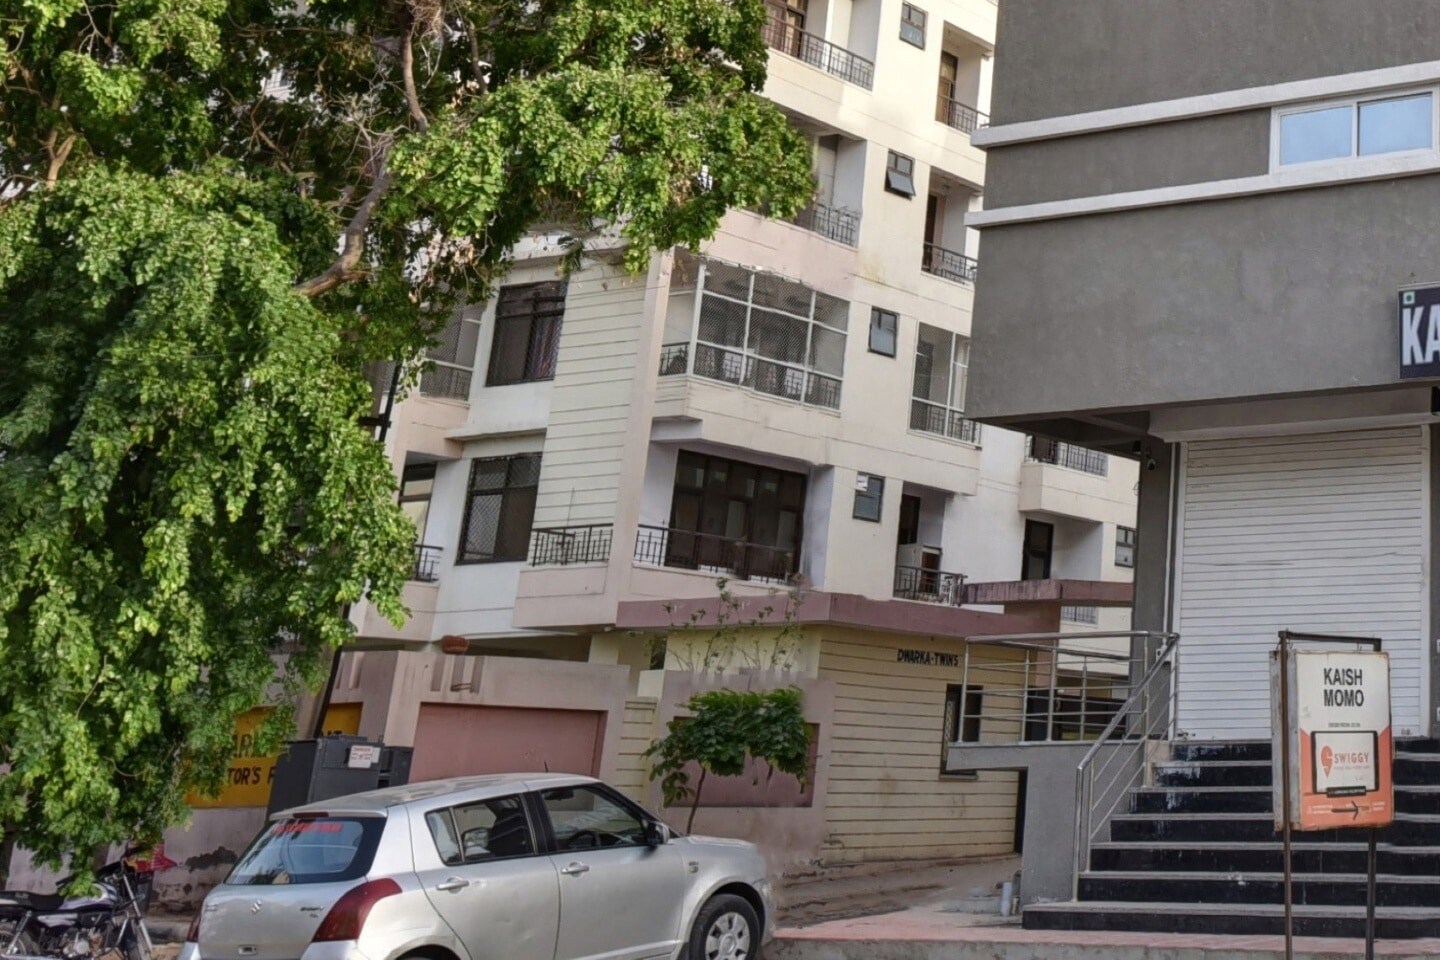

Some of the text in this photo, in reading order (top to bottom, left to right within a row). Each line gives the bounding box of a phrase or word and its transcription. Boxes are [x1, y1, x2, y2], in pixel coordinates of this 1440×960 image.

[1323, 668, 1363, 686] KAISH
[1323, 689, 1364, 707] MOMO
[1334, 752, 1370, 764] SWIGGY
